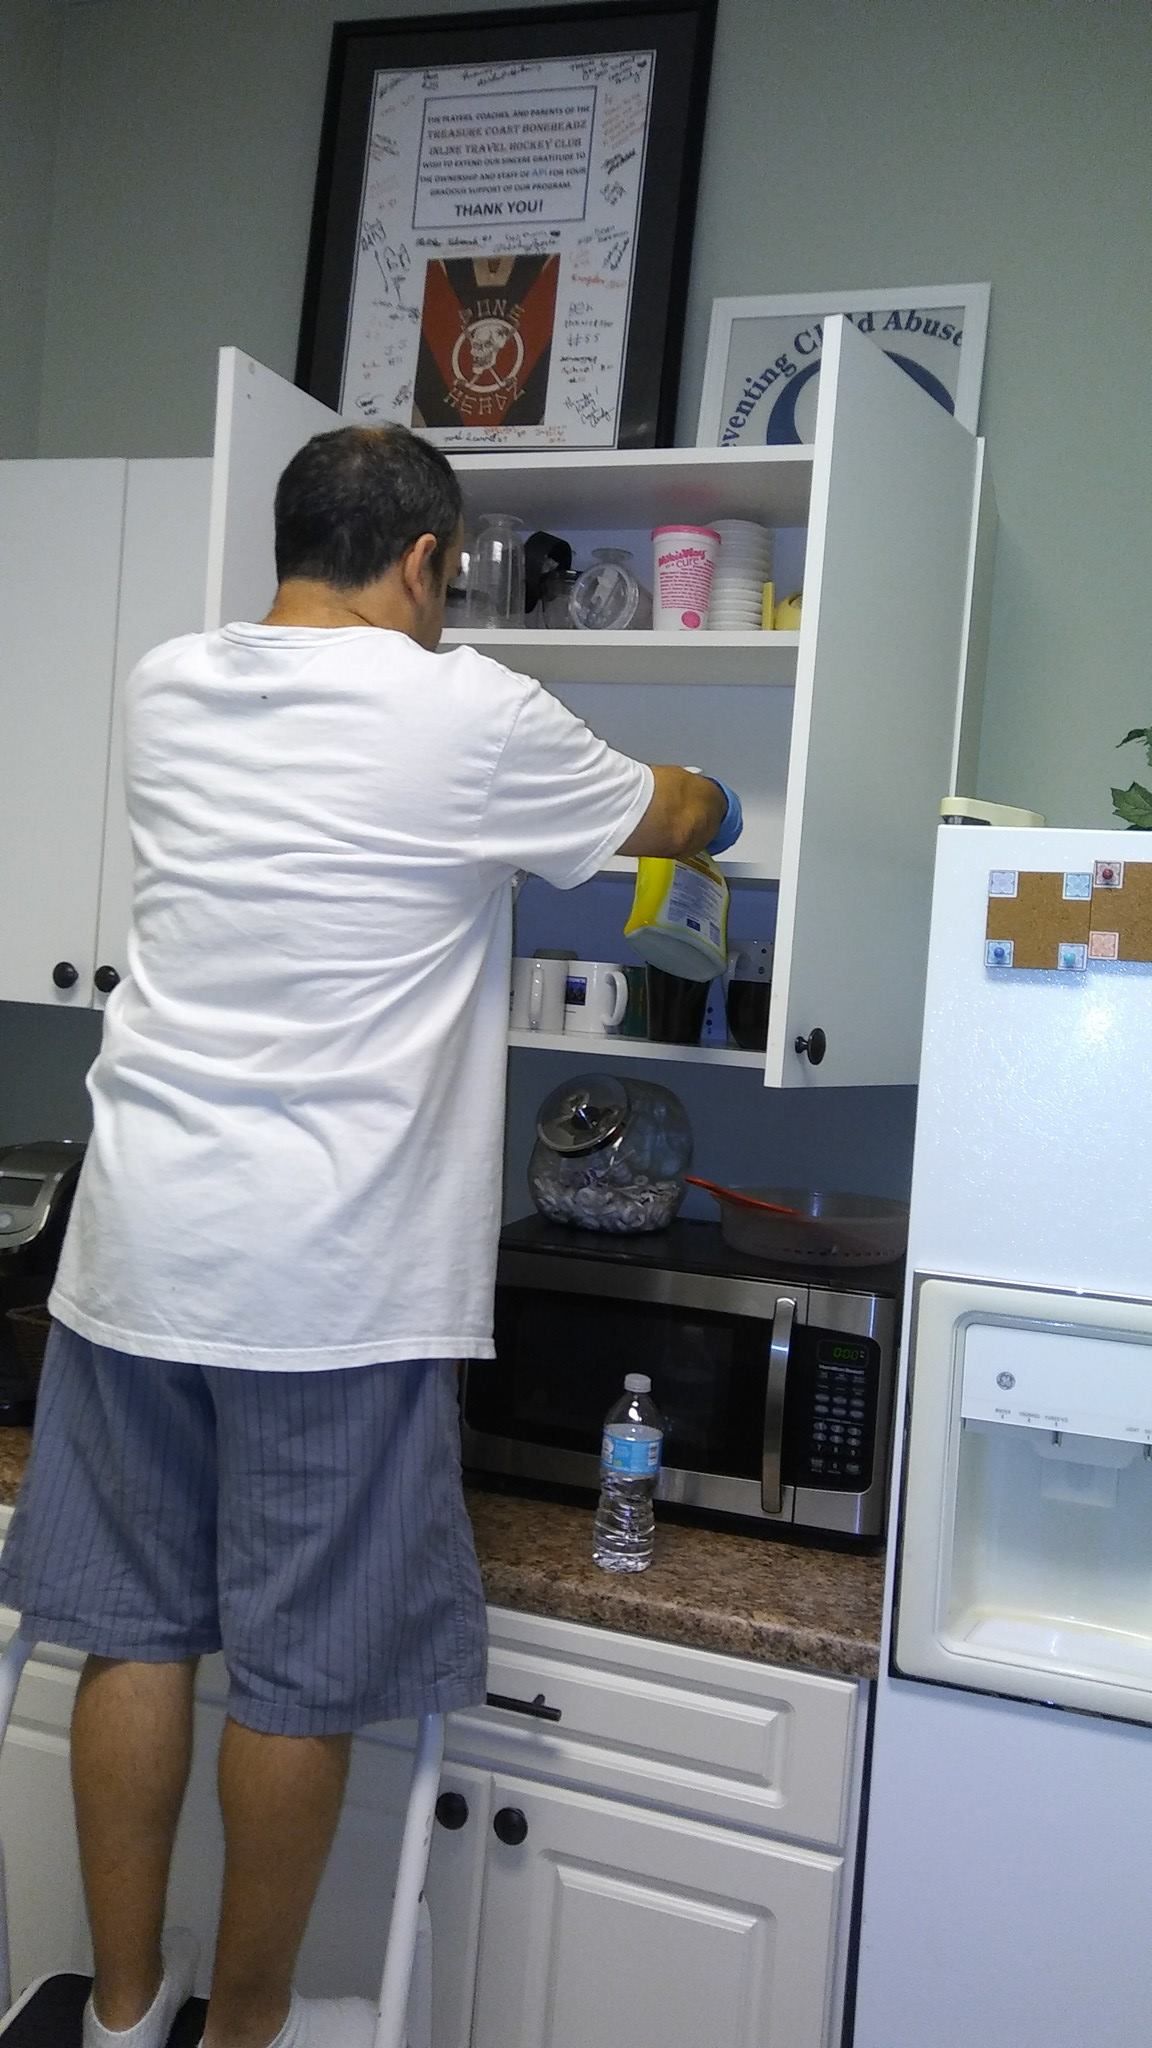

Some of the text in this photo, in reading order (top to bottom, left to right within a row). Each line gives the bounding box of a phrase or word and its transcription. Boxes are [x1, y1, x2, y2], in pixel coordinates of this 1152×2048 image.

[427, 116, 441, 124] THE
[513, 109, 529, 118] AND
[530, 108, 563, 117] PARENTS
[564, 106, 575, 115] OF
[577, 105, 590, 114] THE
[427, 120, 588, 139] TREASURE COAST BONEHEADZ
[428, 137, 582, 156] INLINE TRAVEL HOCKEY CLUB
[422, 152, 586, 169] WISH TO EXTEND OUR SINCERE GRATITUDE TO
[420, 175, 433, 183] THE
[434, 173, 479, 183] OWNERSHIP
[480, 172, 496, 181] AND
[499, 171, 518, 180] STAFF
[519, 170, 530, 179] OF
[549, 168, 564, 177] FOR
[565, 167, 587, 176] YOUR
[429, 187, 467, 197] GRACIOUS
[468, 185, 501, 195] SUPPORT
[503, 184, 513, 193] OF
[514, 183, 531, 192] OUR
[454, 199, 544, 217] THANK YOU!
[882, 309, 964, 348] Abuse
